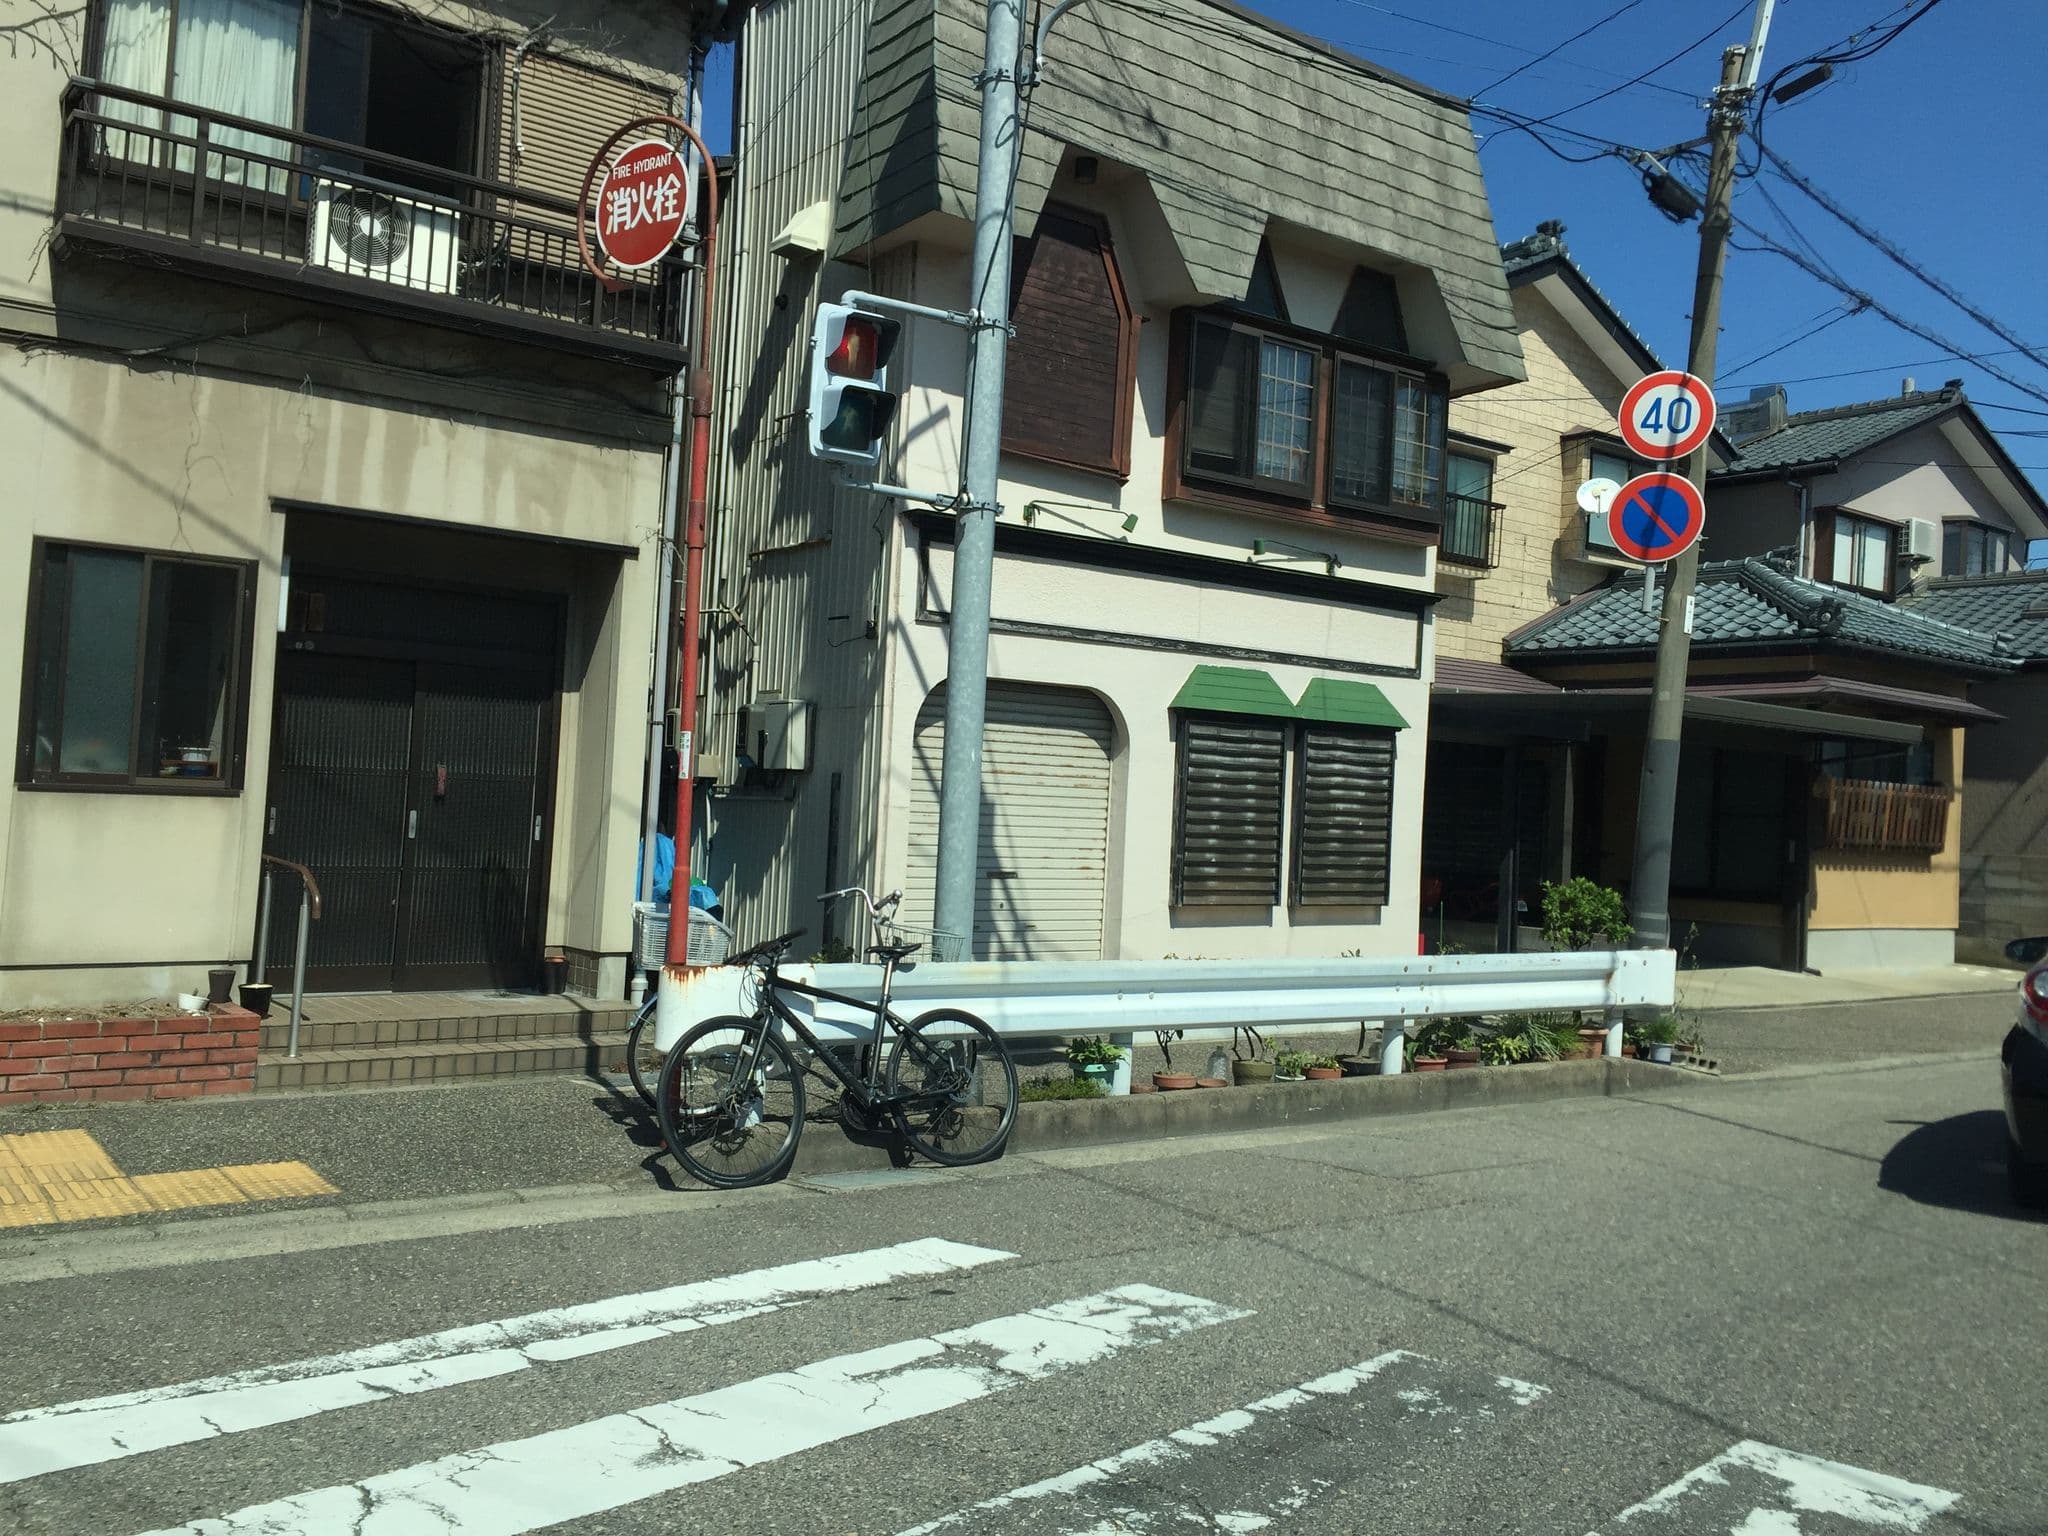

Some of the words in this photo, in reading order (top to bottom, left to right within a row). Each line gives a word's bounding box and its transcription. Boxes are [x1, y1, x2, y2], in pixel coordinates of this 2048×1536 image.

[613, 164, 631, 180] FIRE
[633, 152, 673, 174] HYDRANT
[605, 172, 681, 235] 消火栓
[1640, 397, 1692, 434] 40
